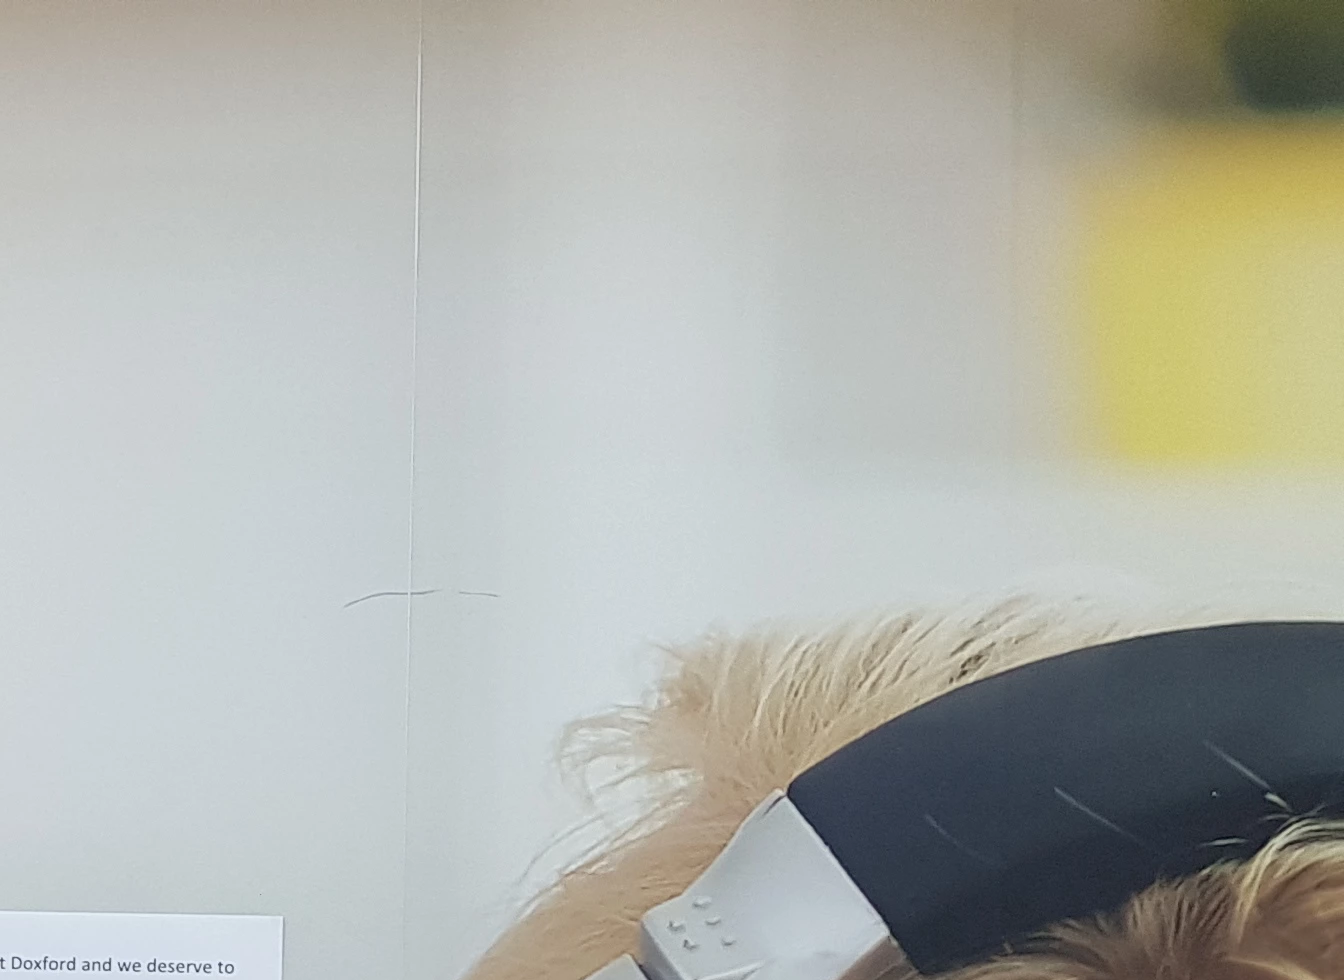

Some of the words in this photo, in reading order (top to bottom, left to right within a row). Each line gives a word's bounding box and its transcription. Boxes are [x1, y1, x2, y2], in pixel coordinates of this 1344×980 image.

[11, 955, 75, 971] Doxford
[81, 957, 111, 971] and
[117, 961, 141, 972] we
[146, 958, 212, 973] deserve
[217, 961, 234, 974] to
